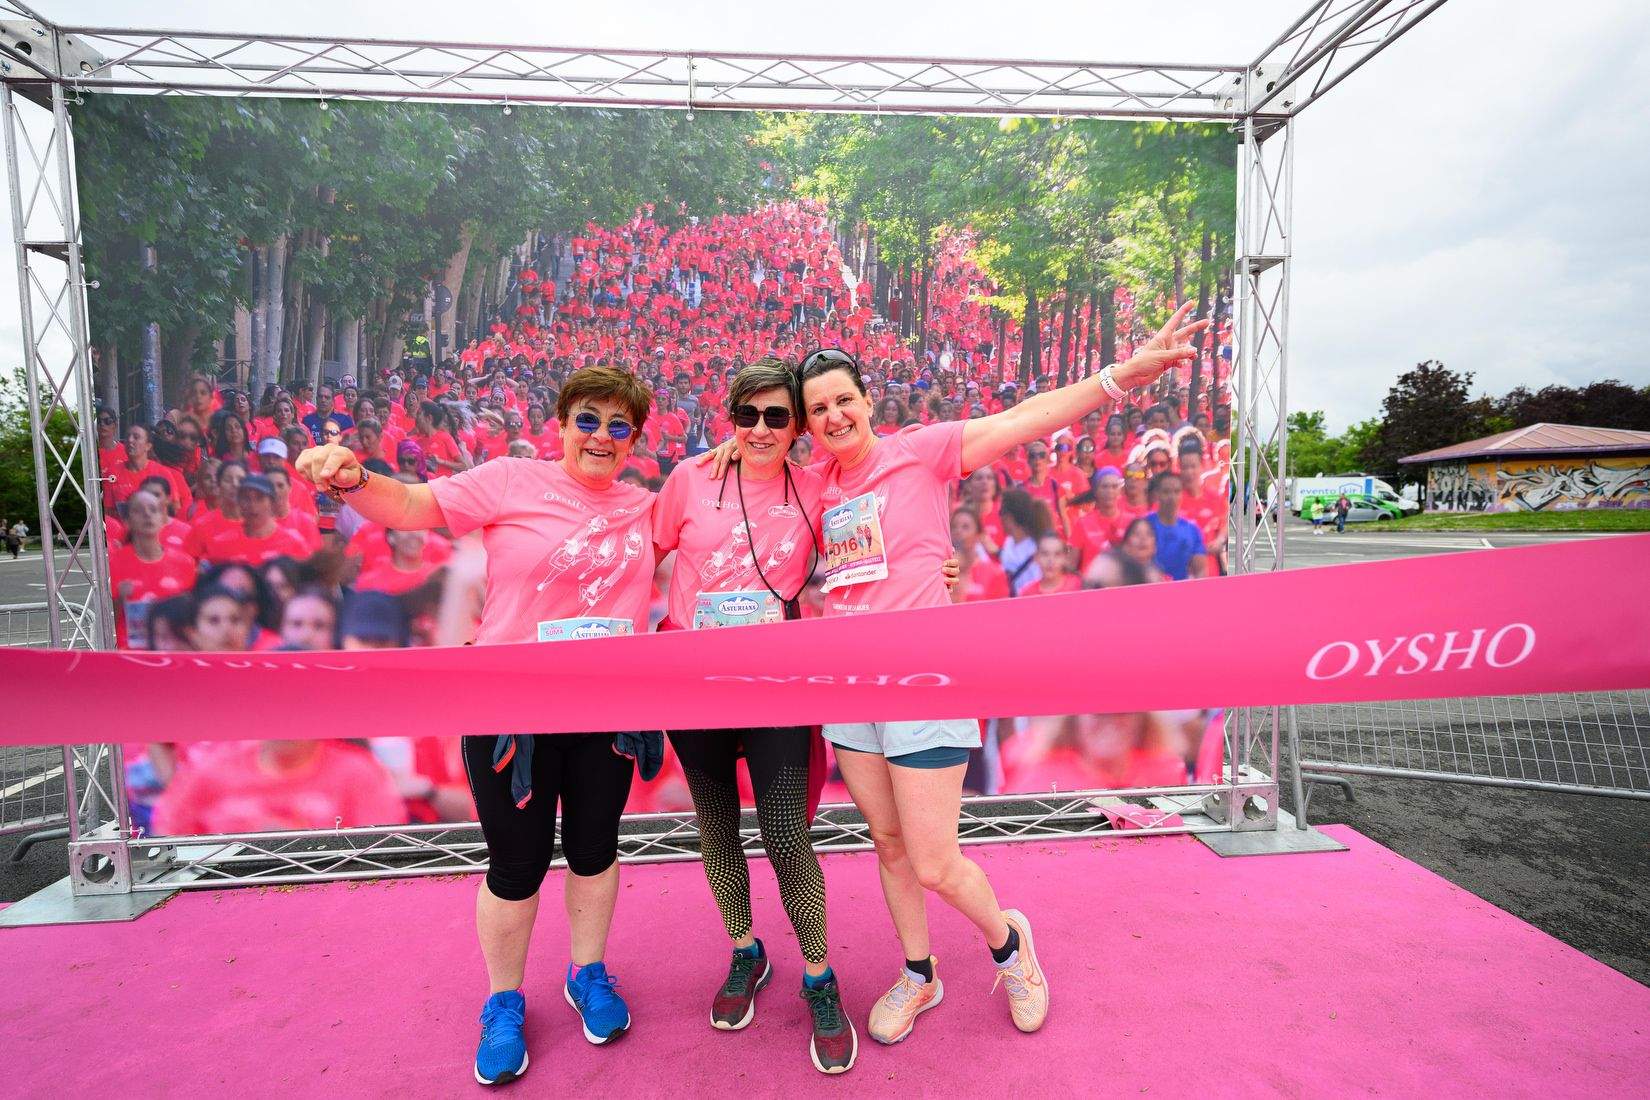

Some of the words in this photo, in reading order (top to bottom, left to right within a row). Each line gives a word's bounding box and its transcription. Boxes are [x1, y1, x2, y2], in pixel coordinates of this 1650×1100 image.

[1300, 487, 1336, 495] evento
[721, 604, 757, 613] ASTURIANA
[1304, 622, 1537, 681] OYSHO
